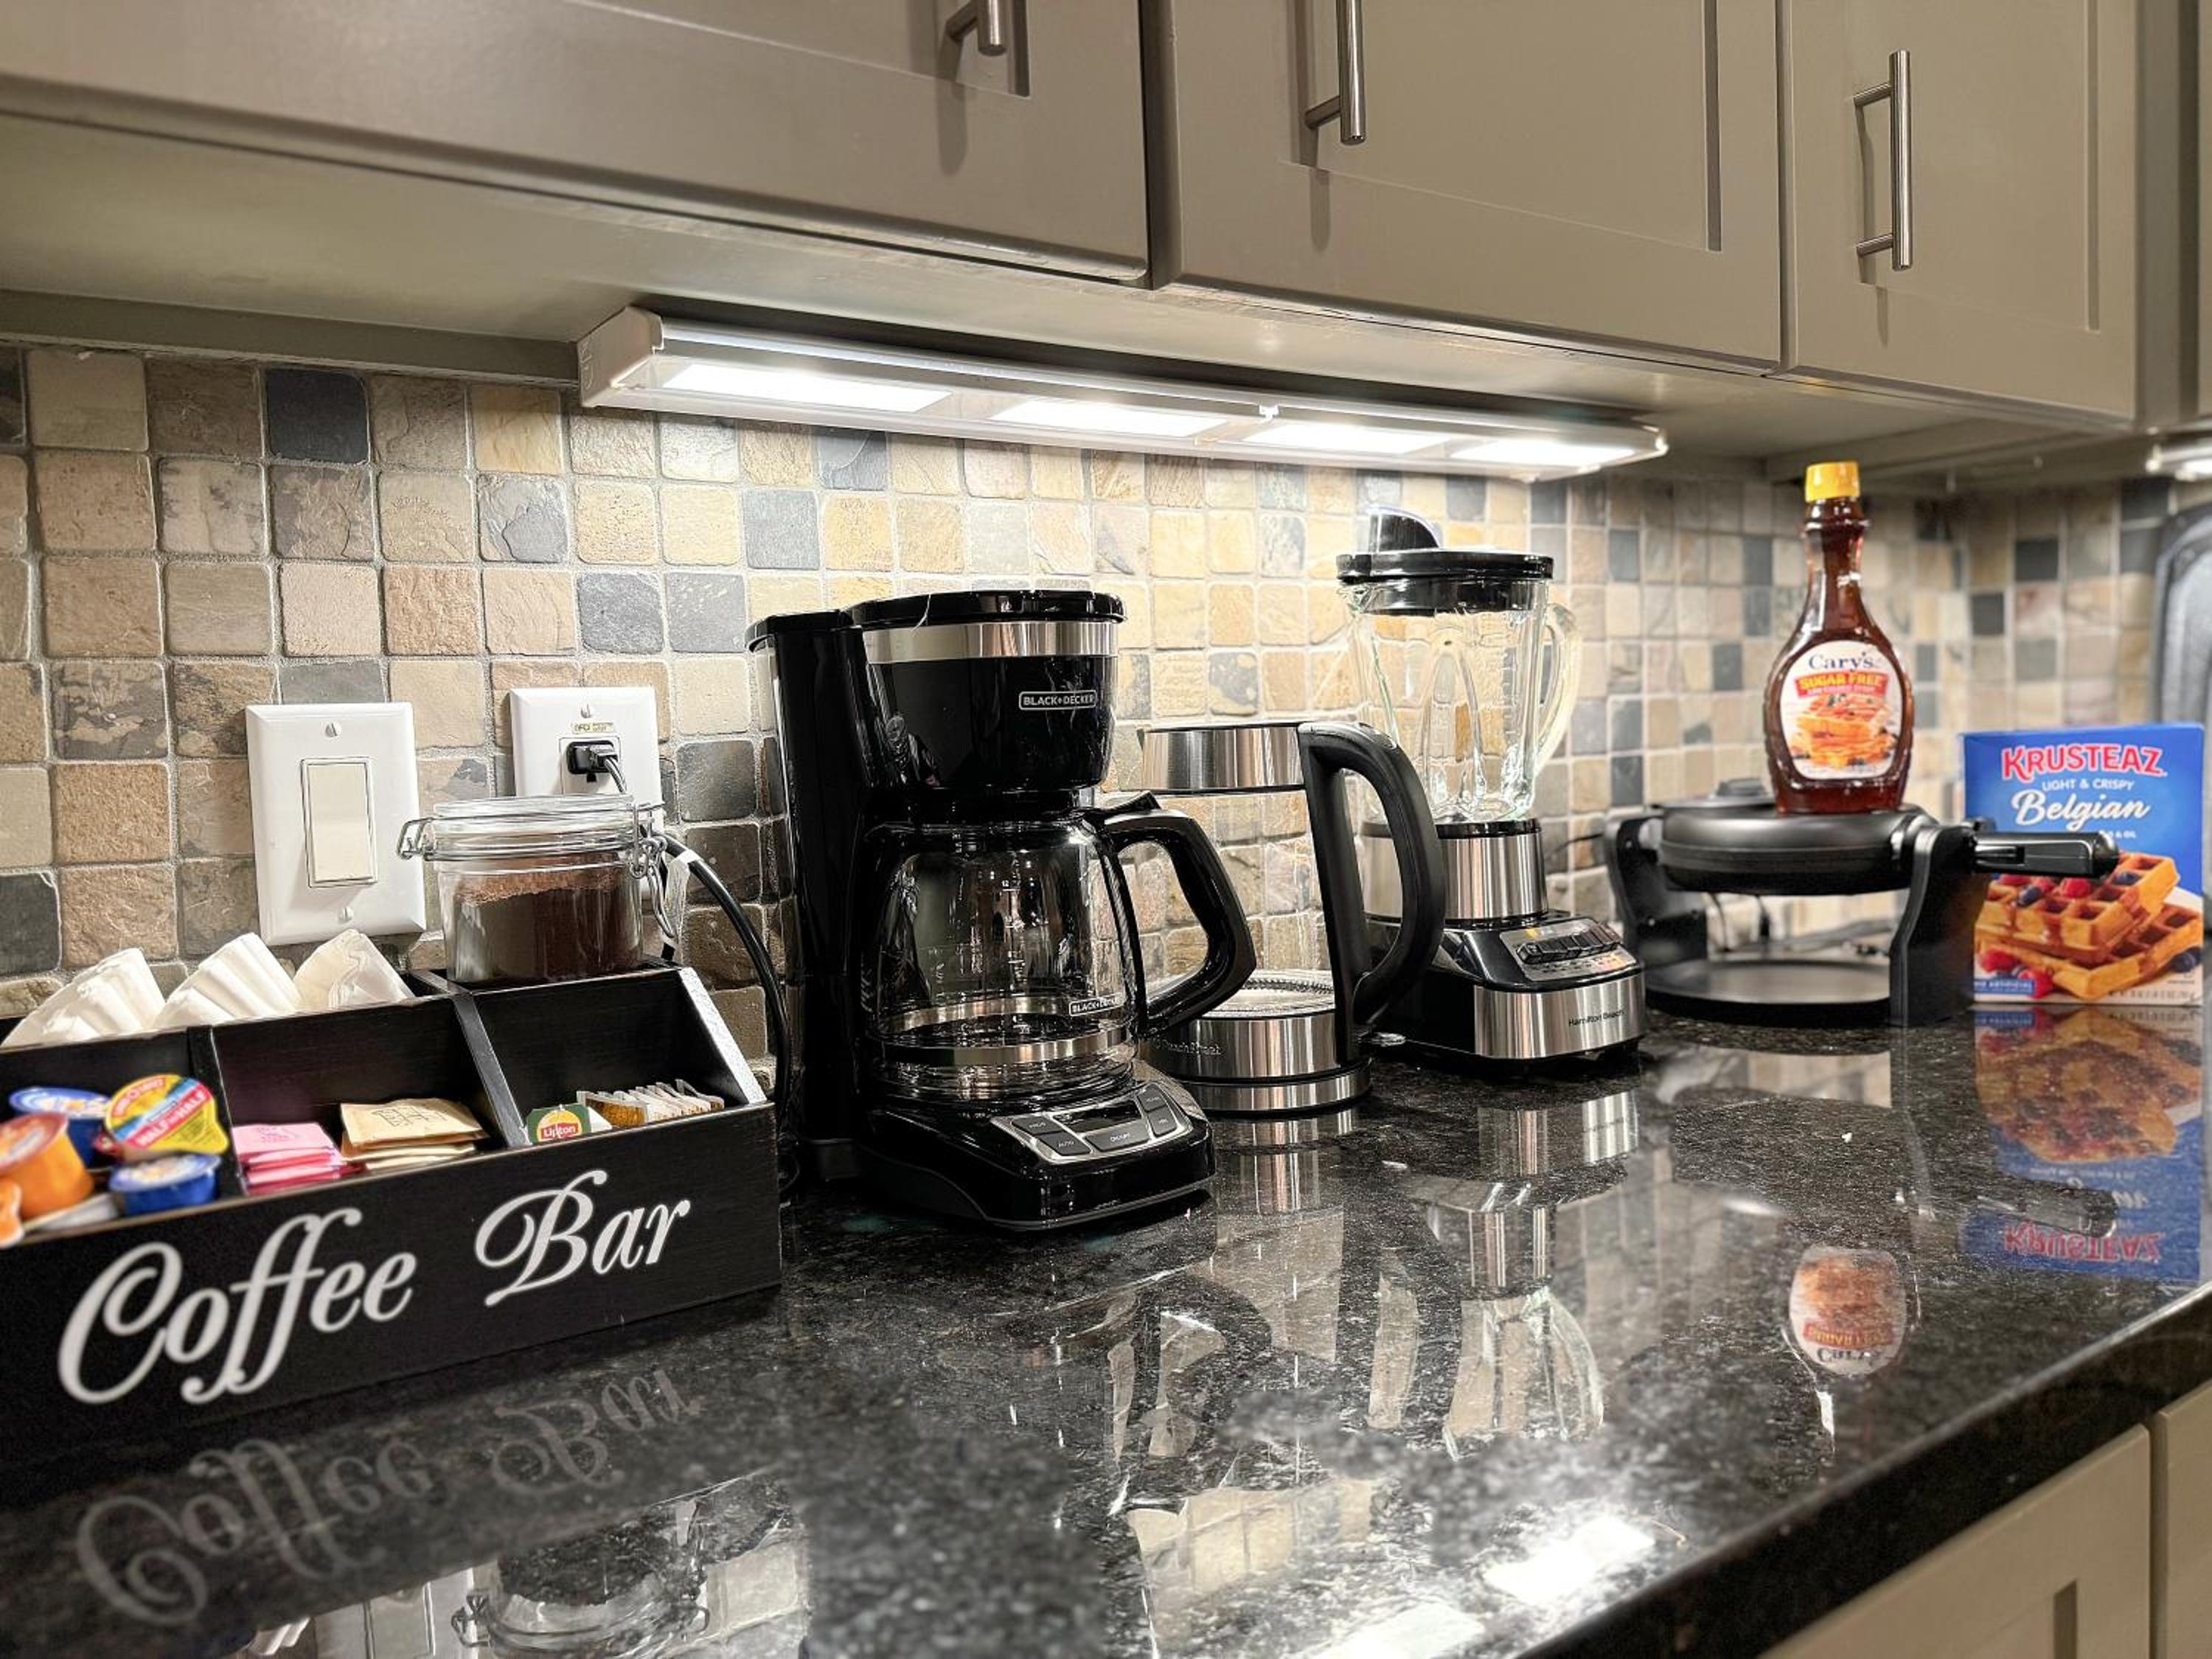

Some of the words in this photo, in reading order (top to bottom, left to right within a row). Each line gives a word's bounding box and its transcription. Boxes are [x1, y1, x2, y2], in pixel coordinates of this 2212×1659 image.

[1809, 651, 1874, 672] Cary's
[1799, 674, 1845, 690] SUGAR
[2002, 743, 2164, 783] KRUSTEAZ
[2042, 779, 2076, 791] LIGHT
[2079, 779, 2090, 789] &
[2093, 778, 2135, 791] CRISPY
[2011, 789, 2151, 832] Belgian
[138, 1119, 170, 1147] HALF
[177, 1089, 207, 1121] HALF
[543, 1125, 577, 1138] Lipton
[58, 1206, 417, 1405] Coffee
[474, 1170, 690, 1307] Bar
